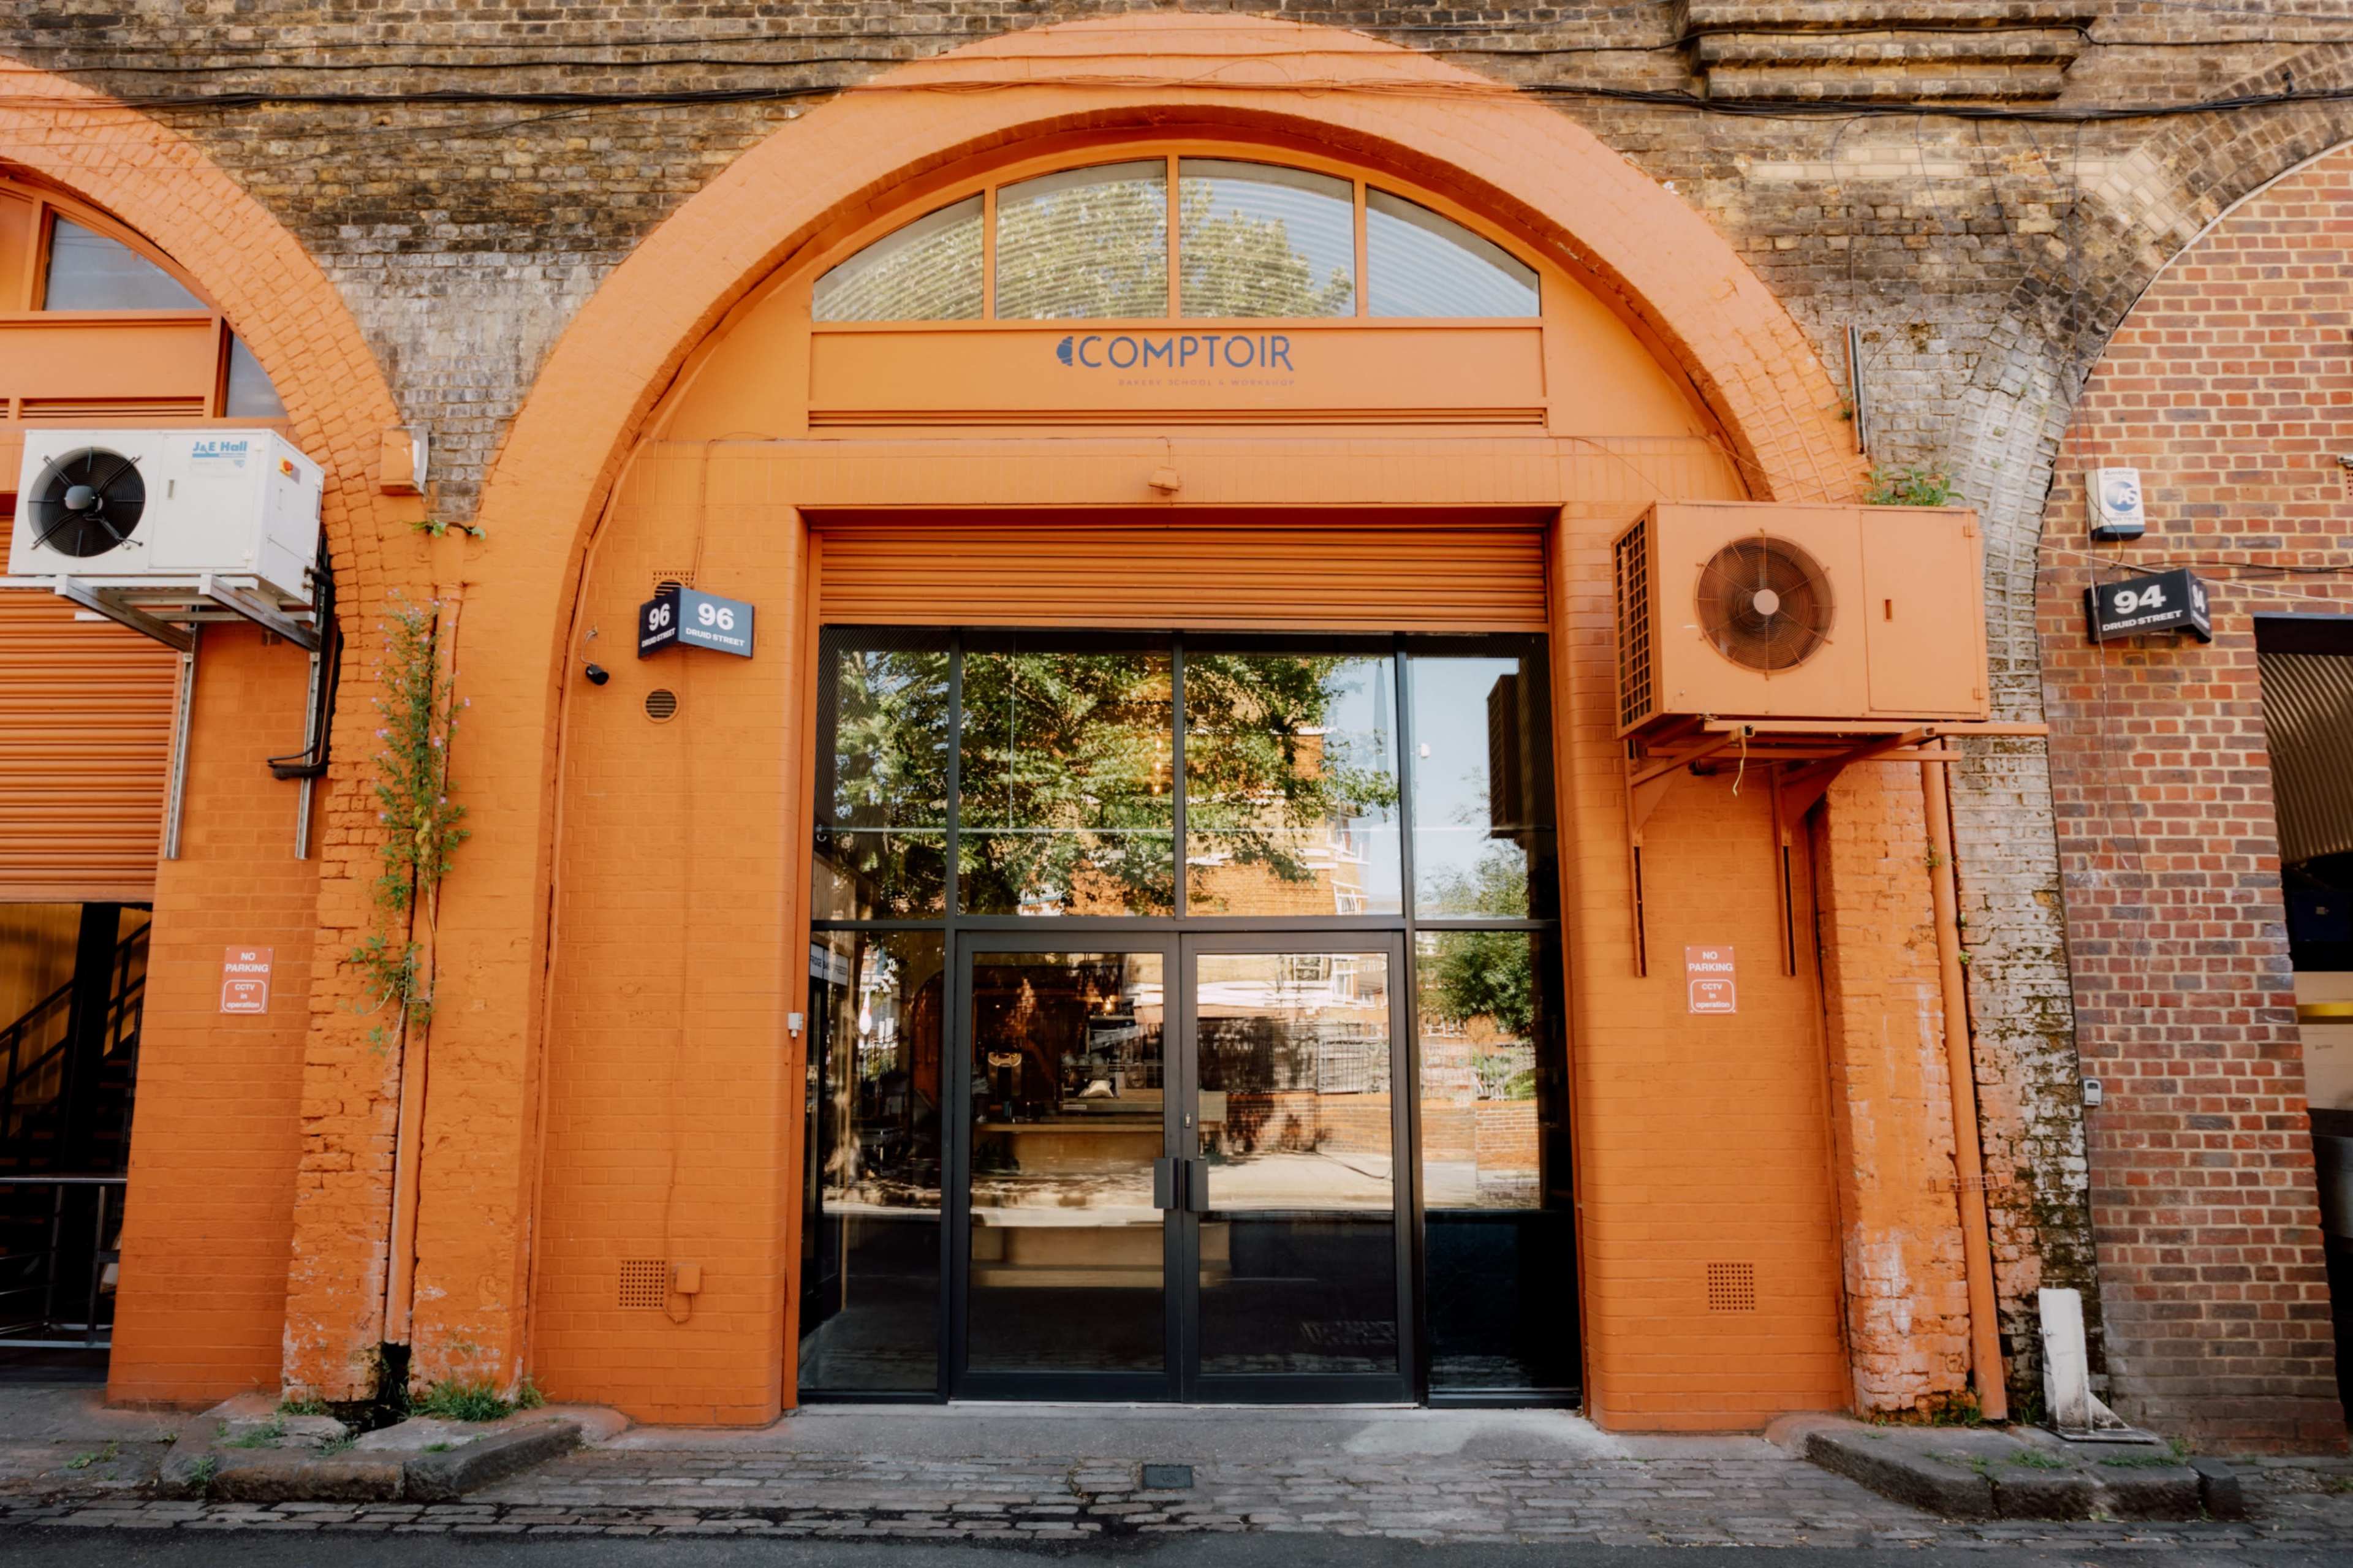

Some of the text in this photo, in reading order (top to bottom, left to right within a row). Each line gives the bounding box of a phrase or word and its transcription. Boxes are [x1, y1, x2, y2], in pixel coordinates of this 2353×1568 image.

[1078, 335, 1294, 371] COMPTOIR
[220, 441, 248, 452] Hall
[2113, 585, 2167, 615] 94
[648, 603, 671, 631] 96
[698, 603, 735, 631] 96
[2102, 618, 2137, 632] DRUID
[2137, 610, 2183, 625] STREET
[642, 627, 676, 648] DRUID STREET
[685, 627, 745, 646] DRUID STREET
[240, 952, 256, 961] NO
[1702, 951, 1718, 960] NO
[225, 963, 268, 973] PARKING
[1688, 963, 1733, 971] PARKING
